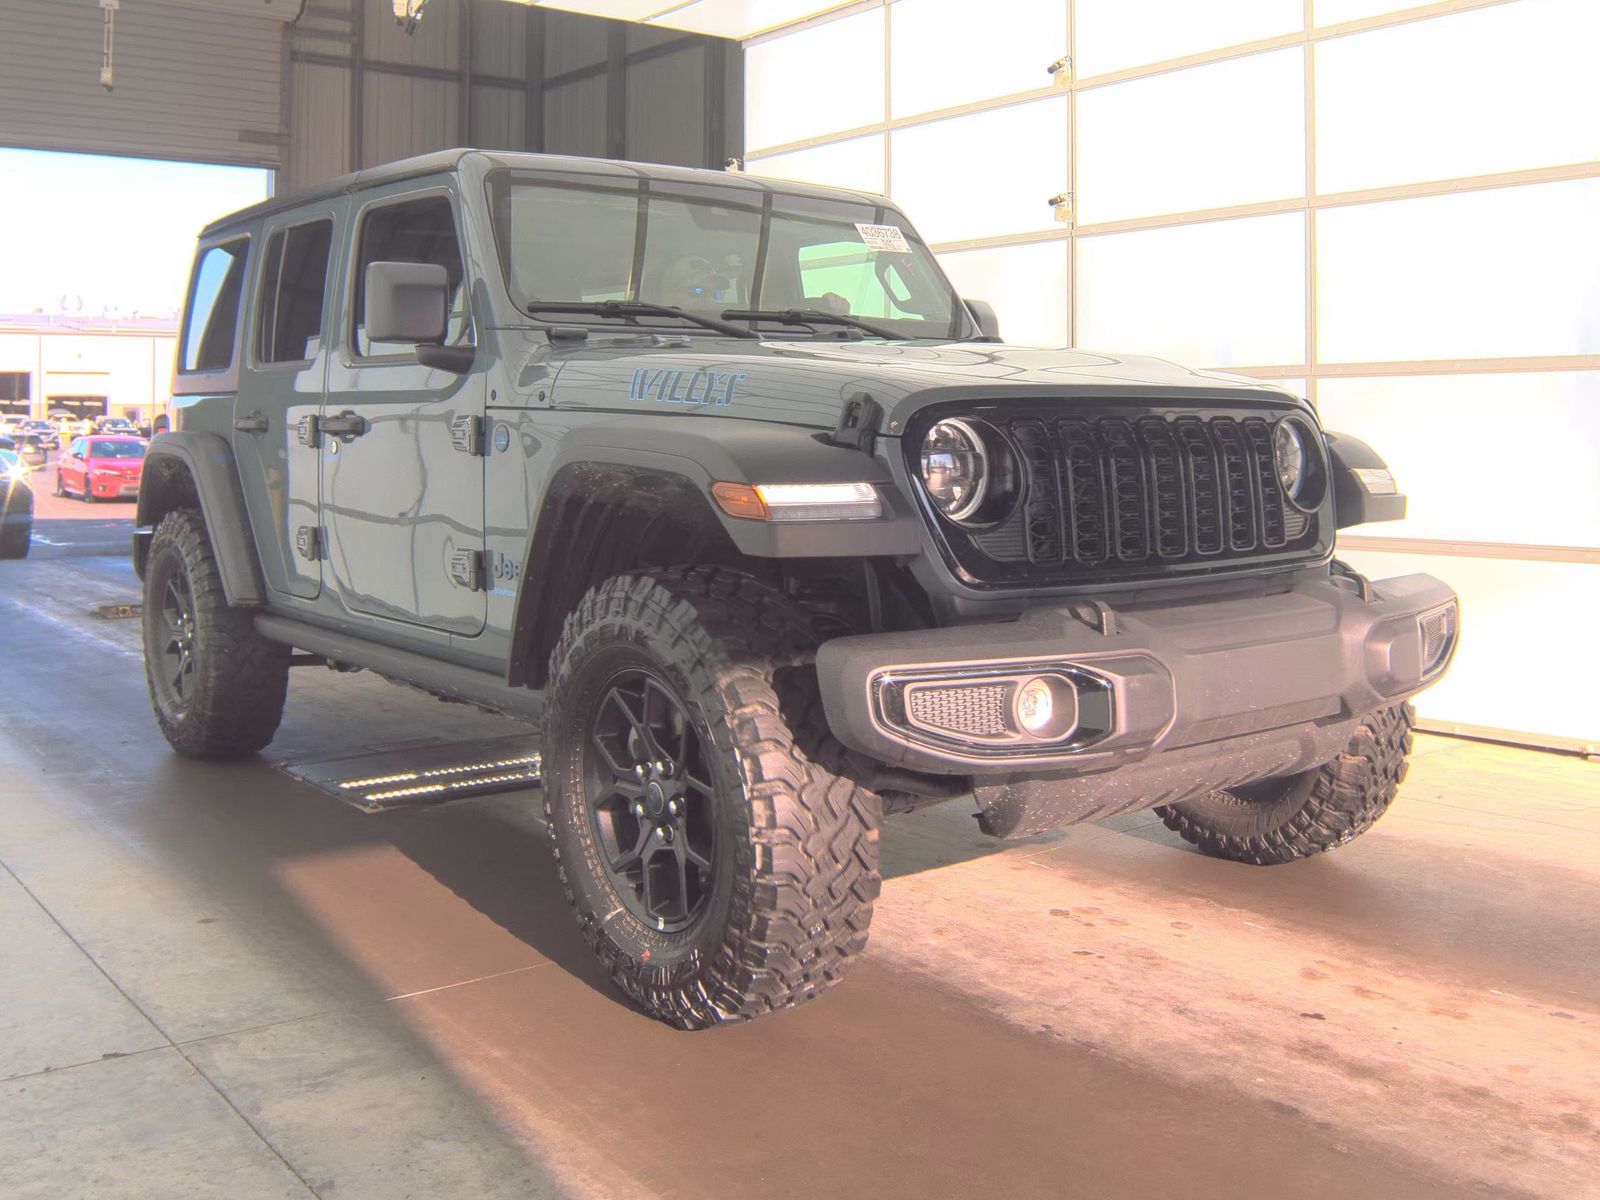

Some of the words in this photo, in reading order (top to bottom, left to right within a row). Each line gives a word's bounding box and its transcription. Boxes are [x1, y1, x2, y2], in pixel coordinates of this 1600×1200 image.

[861, 226, 902, 239] 4036738
[630, 368, 748, 406] WILLYS
[493, 552, 523, 580] Jee
